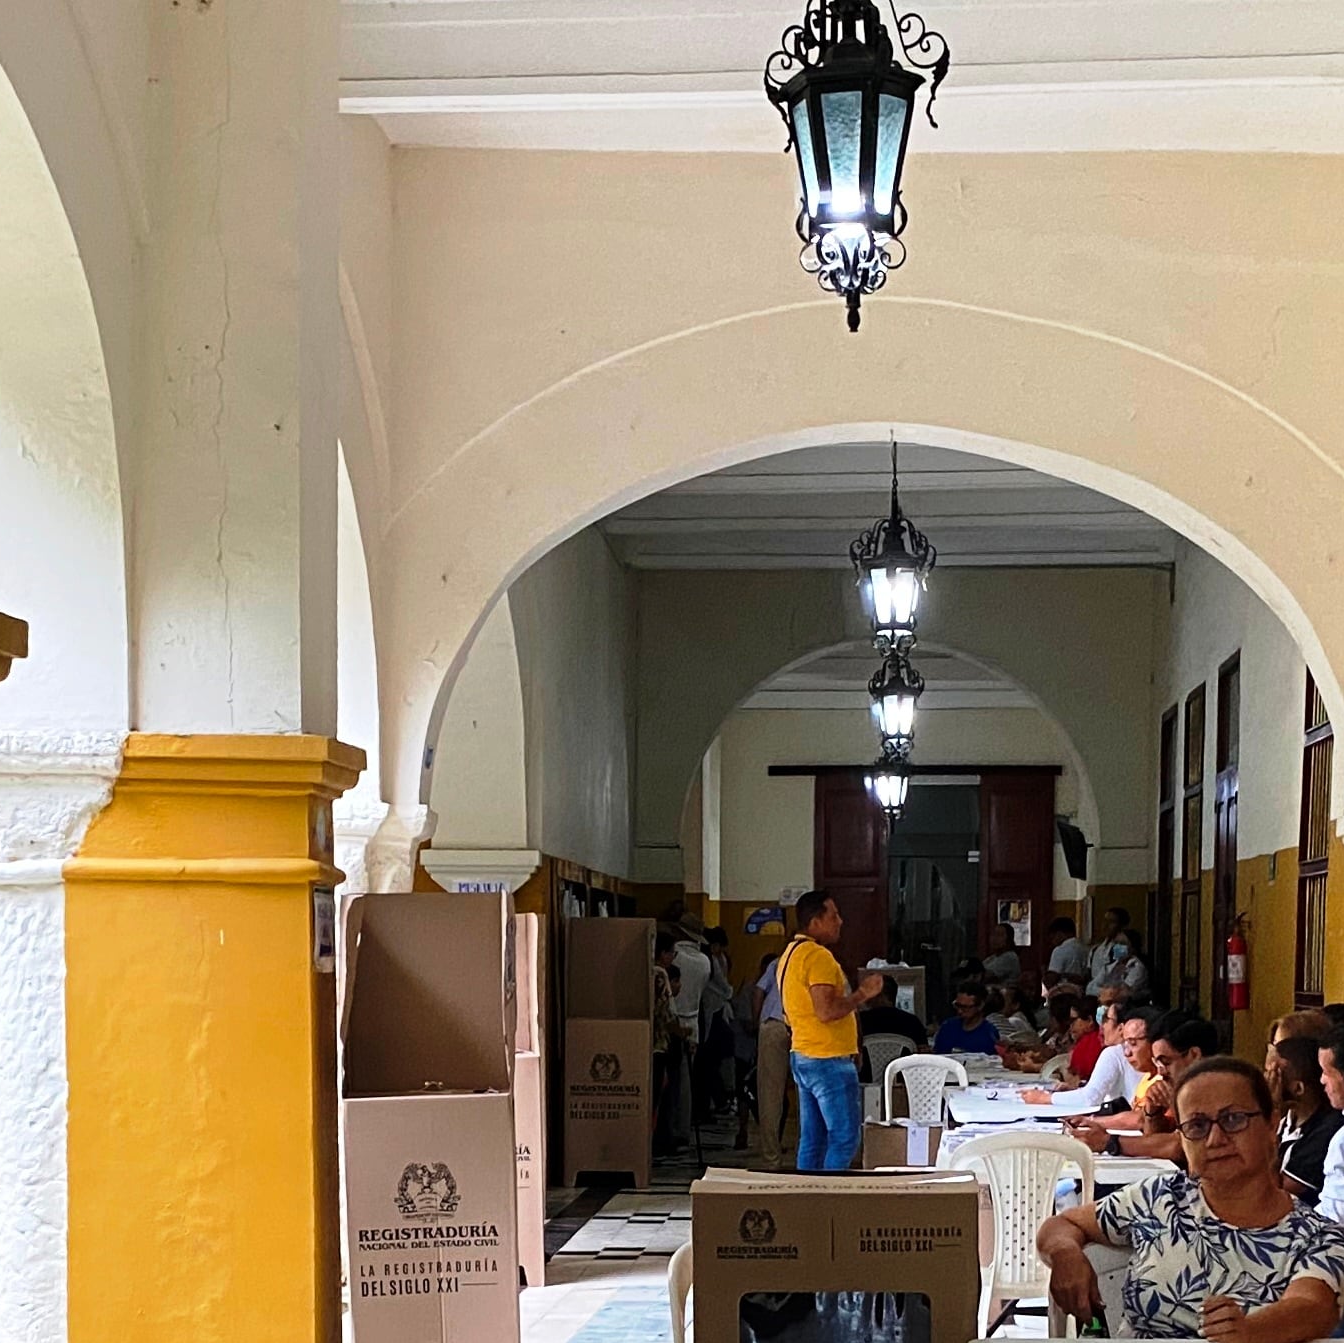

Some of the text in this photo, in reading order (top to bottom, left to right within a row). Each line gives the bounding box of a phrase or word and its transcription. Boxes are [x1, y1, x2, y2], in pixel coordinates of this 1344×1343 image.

[358, 1221, 499, 1243] REGISTRADURÍA
[358, 1238, 500, 1251] NACIONAL DEL ESTADO CIVIL
[360, 1258, 498, 1277] LA REGISTRADURÍA
[437, 1277, 459, 1294] XXI
